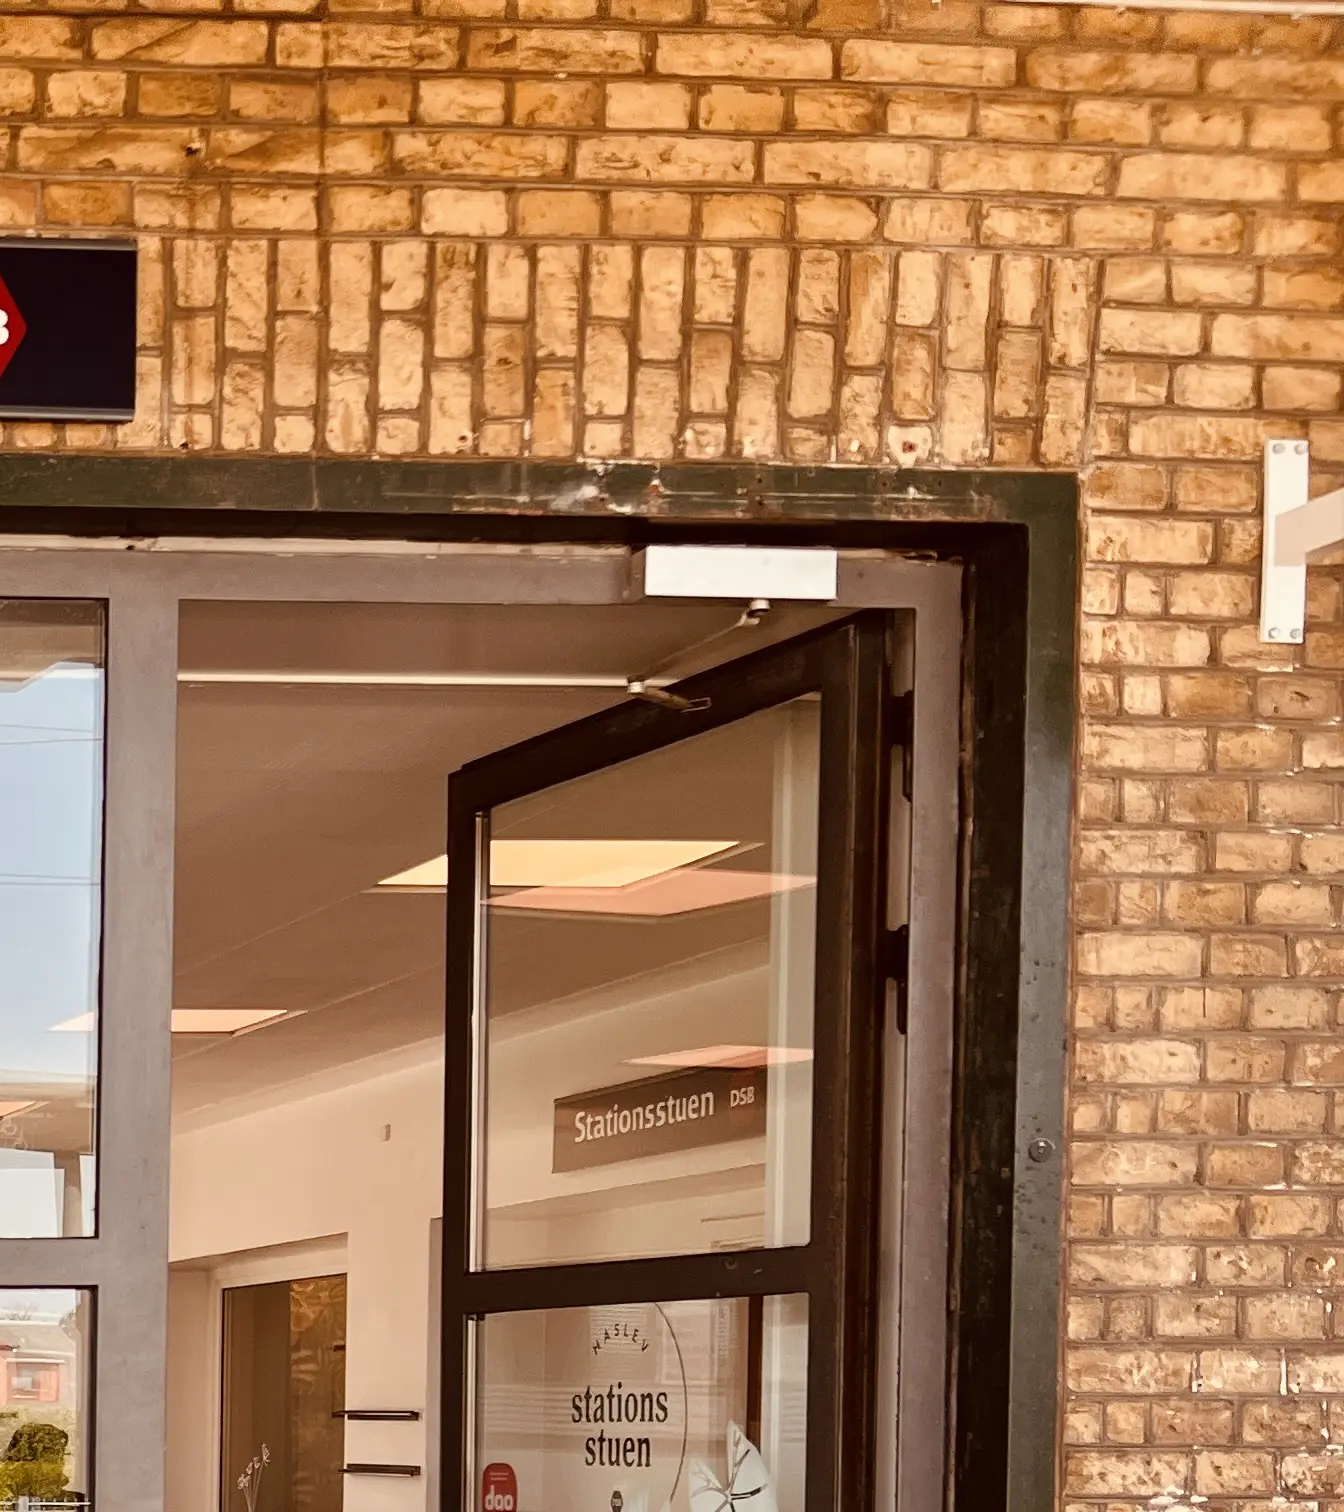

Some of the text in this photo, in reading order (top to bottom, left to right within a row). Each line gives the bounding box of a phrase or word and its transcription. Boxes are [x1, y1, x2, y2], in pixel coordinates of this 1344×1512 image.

[573, 1086, 755, 1143] Stationsstuen DSB
[591, 1323, 650, 1355] HASLEV
[570, 1381, 669, 1423] stations
[584, 1429, 652, 1468] stuen
